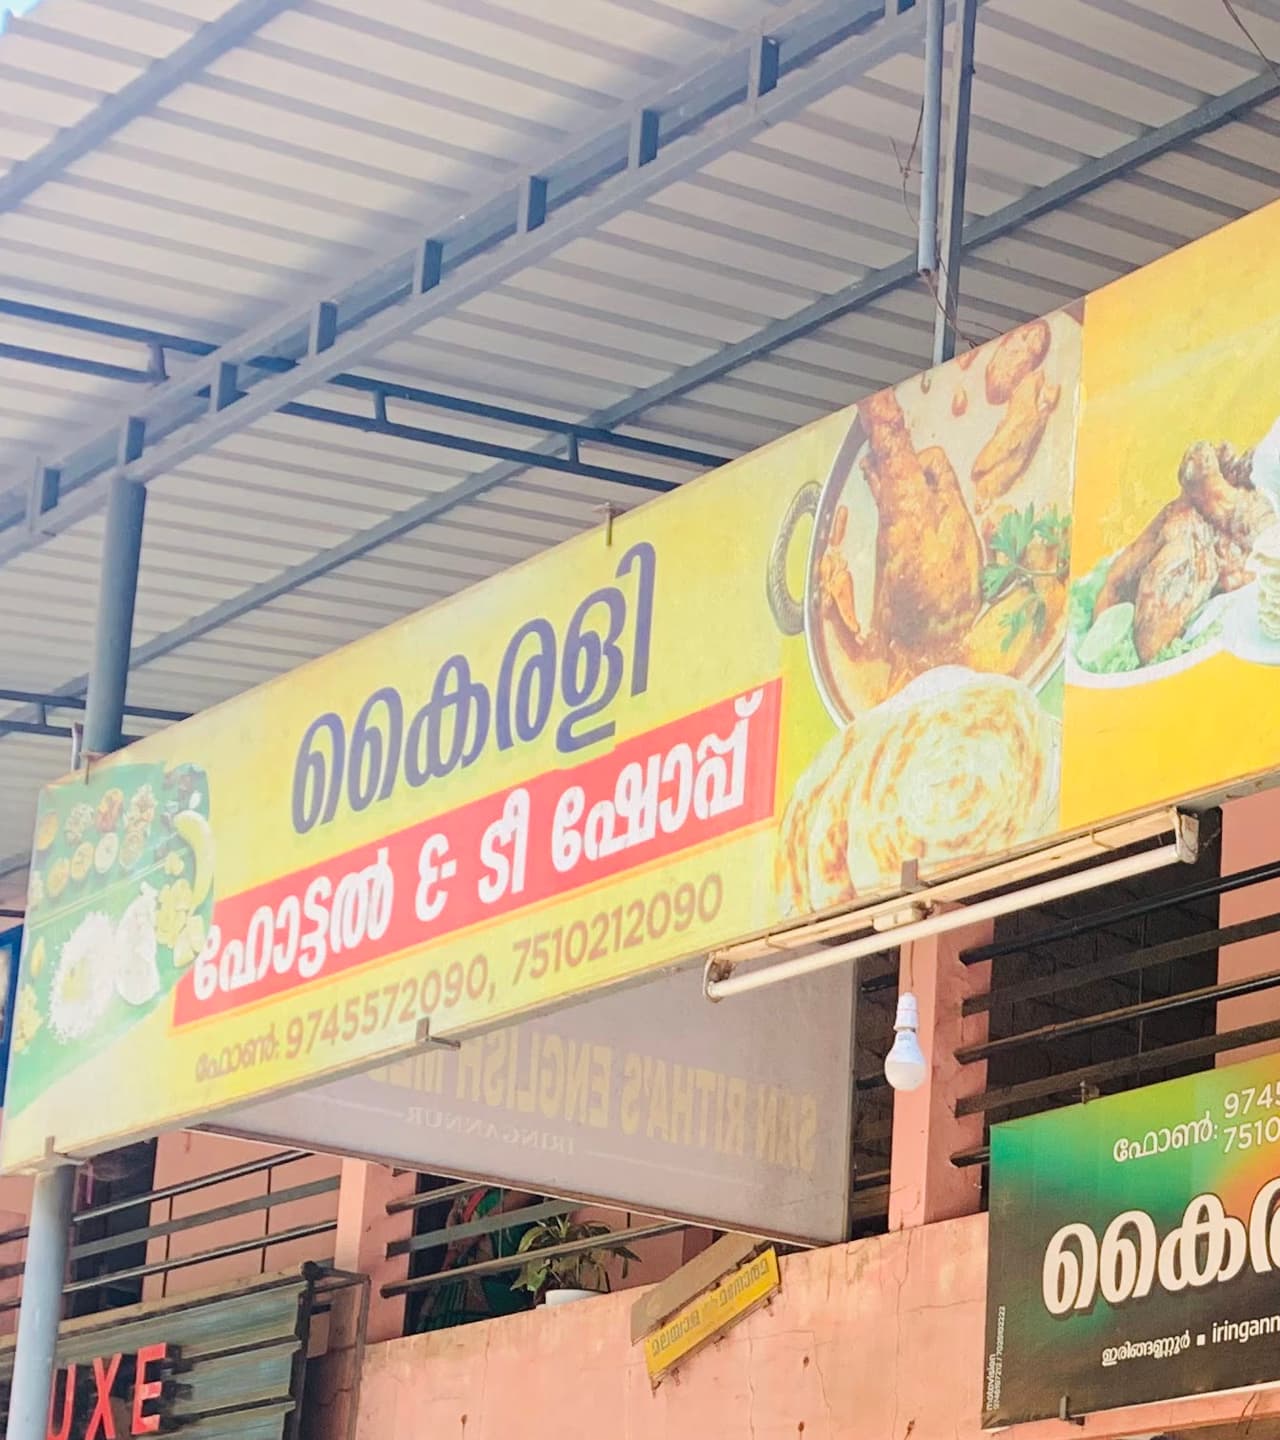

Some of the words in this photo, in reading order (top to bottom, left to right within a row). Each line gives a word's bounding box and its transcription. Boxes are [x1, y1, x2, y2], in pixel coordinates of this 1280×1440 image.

[292, 542, 657, 835] കൈരളി
[193, 847, 394, 1000] ഹോട്ടൽ
[478, 788, 528, 904] ടീ
[550, 690, 765, 873] ഷോപ്പ്
[286, 953, 496, 1061] 9745572090,
[512, 873, 724, 981] 7510212090
